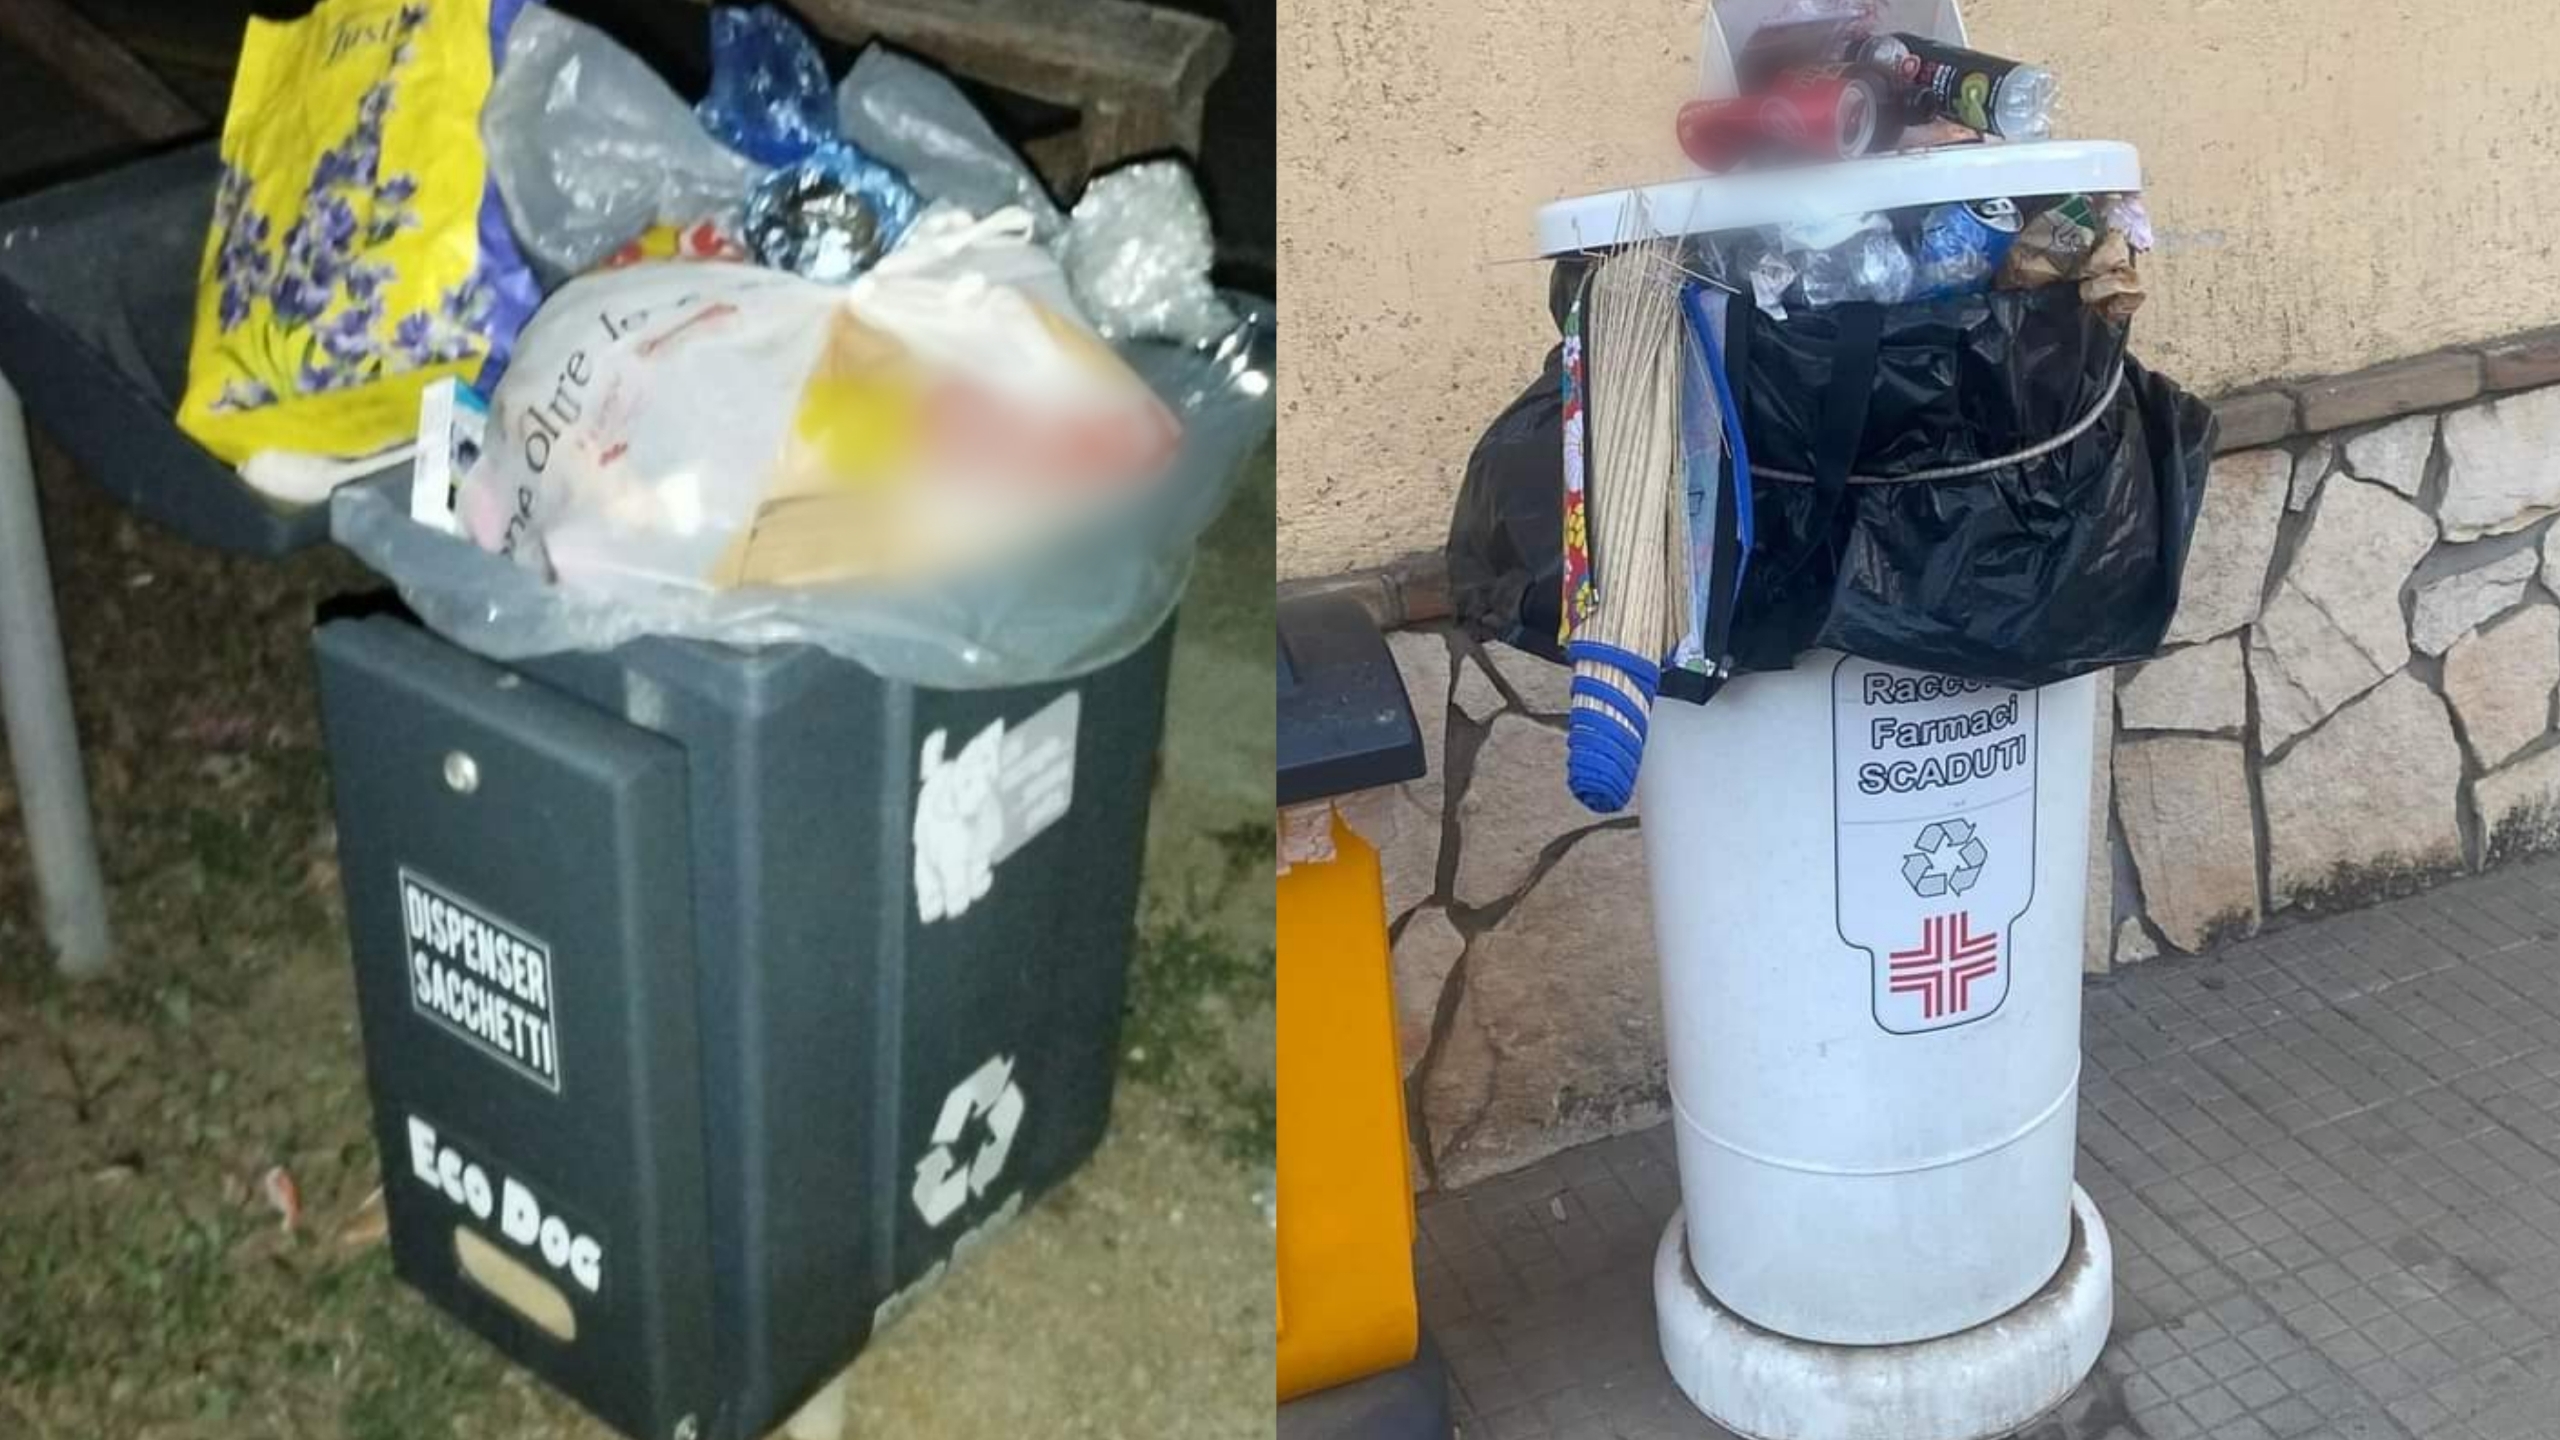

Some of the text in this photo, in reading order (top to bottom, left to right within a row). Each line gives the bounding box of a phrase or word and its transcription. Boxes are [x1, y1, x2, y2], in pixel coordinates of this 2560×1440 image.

[1858, 735, 2026, 795] SCADUTI
[1872, 693, 2018, 750] Farmaci
[407, 884, 546, 1010] DISPENSER
[414, 950, 552, 1076] SACCHETTI
